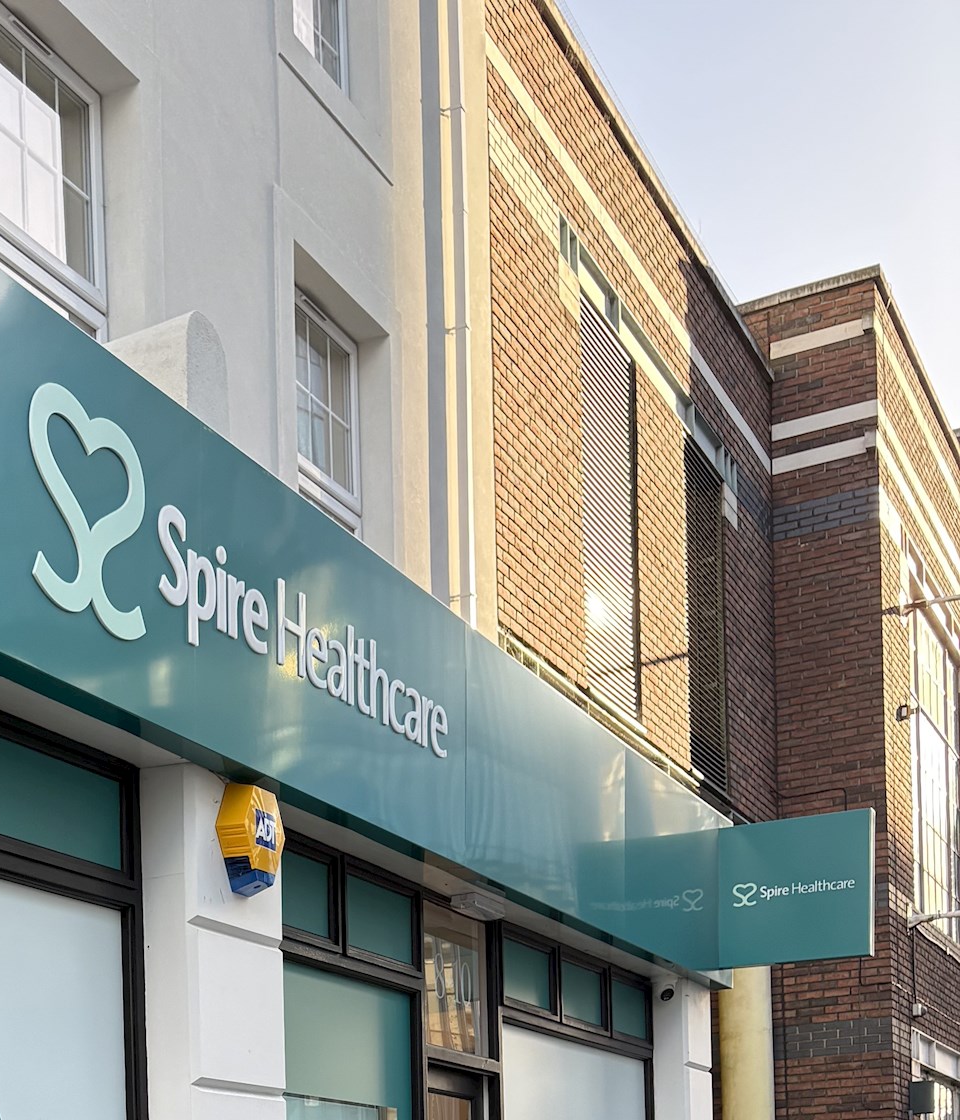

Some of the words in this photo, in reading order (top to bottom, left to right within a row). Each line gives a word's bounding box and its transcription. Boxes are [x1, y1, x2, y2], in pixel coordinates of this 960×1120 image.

[157, 504, 268, 655] Spire
[276, 578, 448, 758] Healthcare
[256, 816, 276, 845] ADT
[760, 885, 789, 900] Spire
[791, 879, 855, 895] Healthcare
